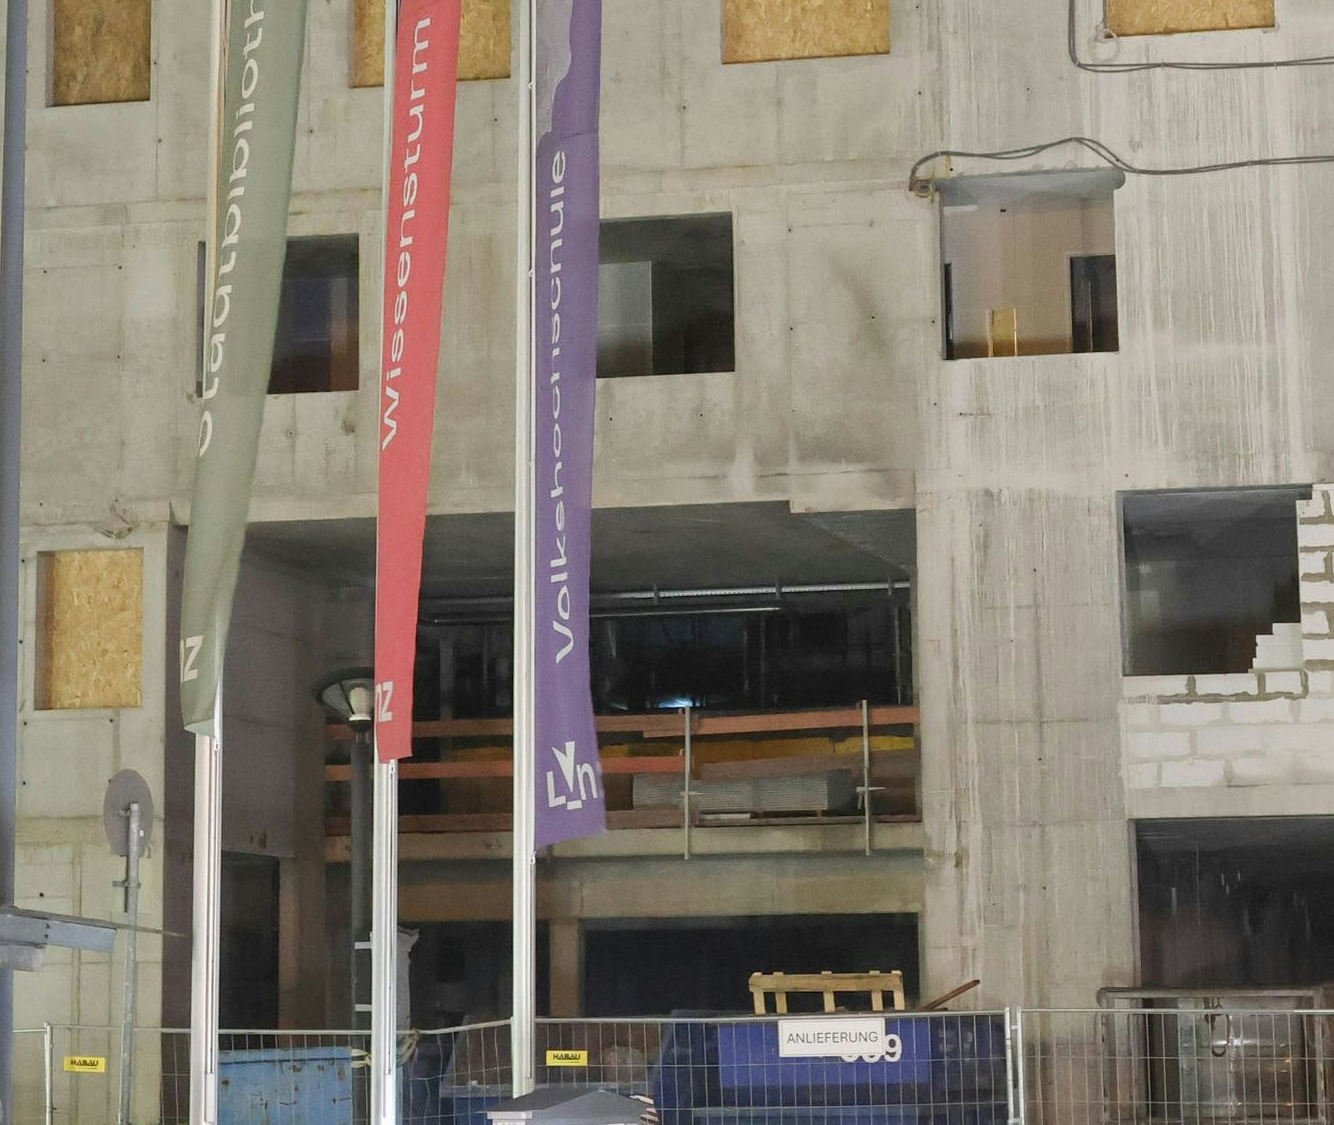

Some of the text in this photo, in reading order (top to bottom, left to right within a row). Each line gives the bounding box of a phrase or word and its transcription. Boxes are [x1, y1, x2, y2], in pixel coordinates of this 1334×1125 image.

[380, 17, 430, 452] Wissensturm
[787, 1031, 879, 1043] ANLIEFERUNG
[553, 1053, 581, 1061] HABAU
[70, 1059, 99, 1067] HABAU
